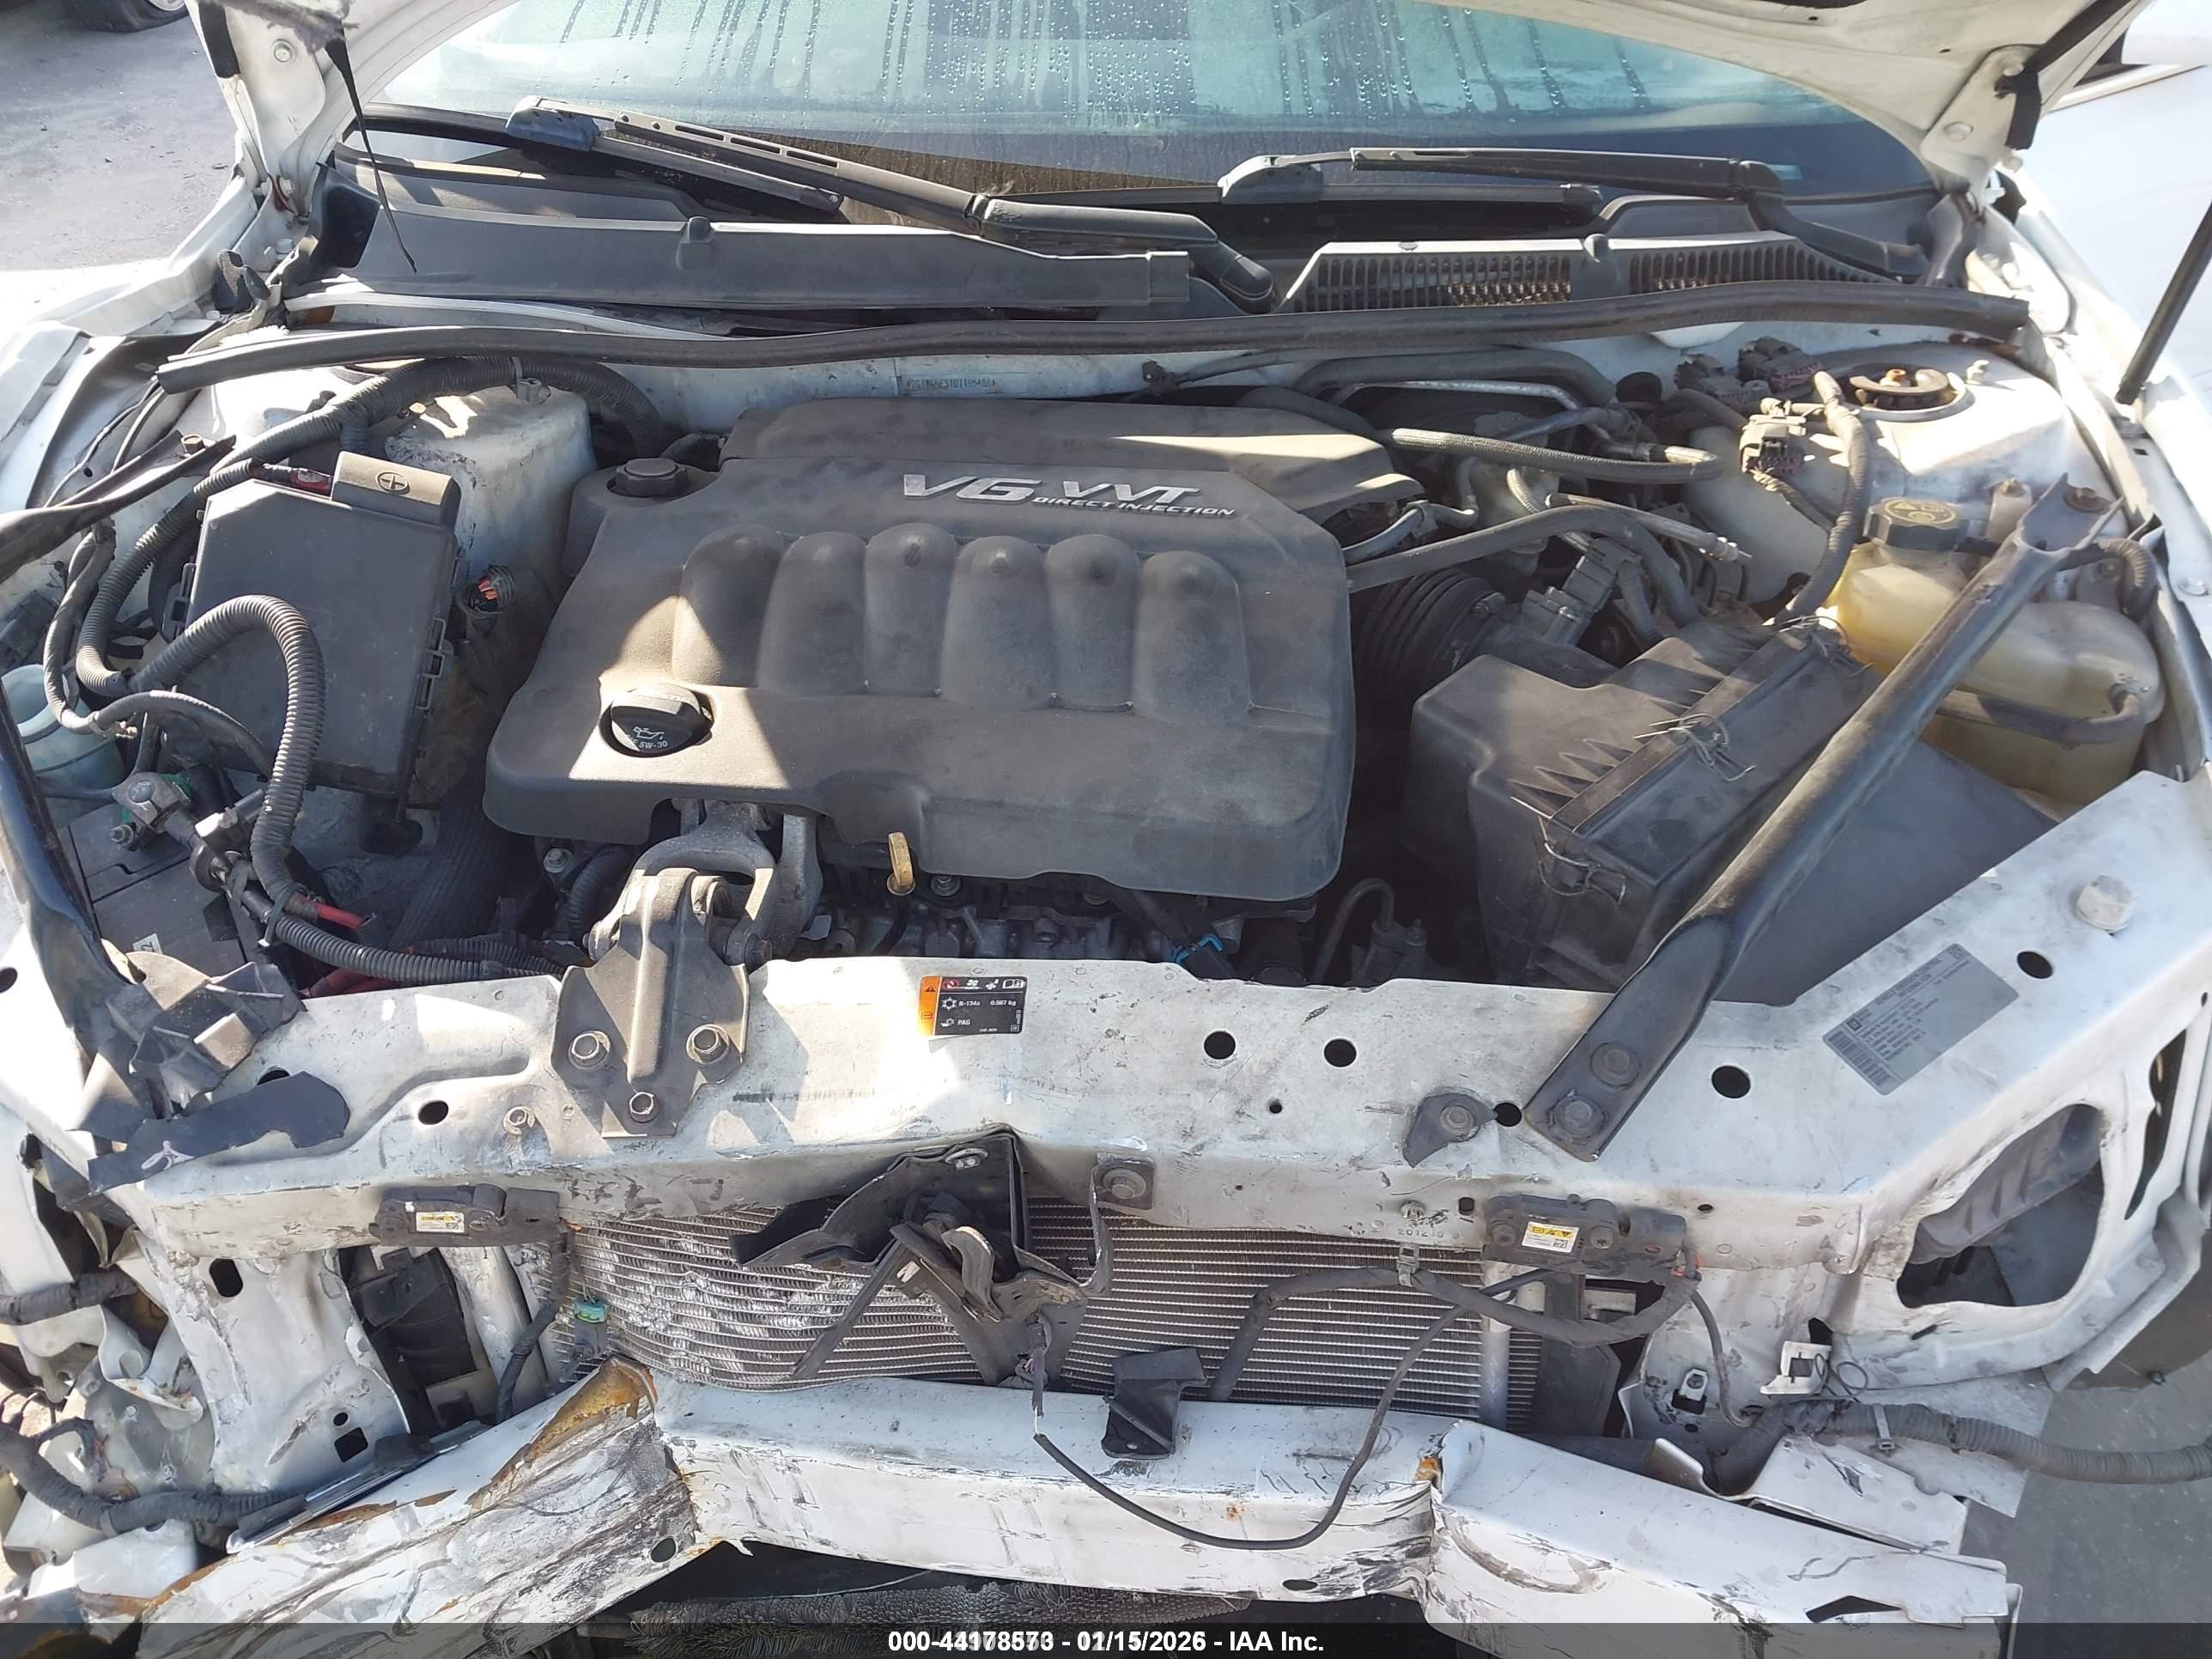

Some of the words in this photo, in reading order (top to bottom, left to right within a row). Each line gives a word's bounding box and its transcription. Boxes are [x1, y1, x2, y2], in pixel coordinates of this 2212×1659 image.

[903, 473, 1042, 504] V6
[1062, 480, 1200, 505] VVT
[1031, 495, 1116, 508] DIRECT
[1117, 501, 1237, 517] INJECTION
[639, 740, 668, 749] 5W-30
